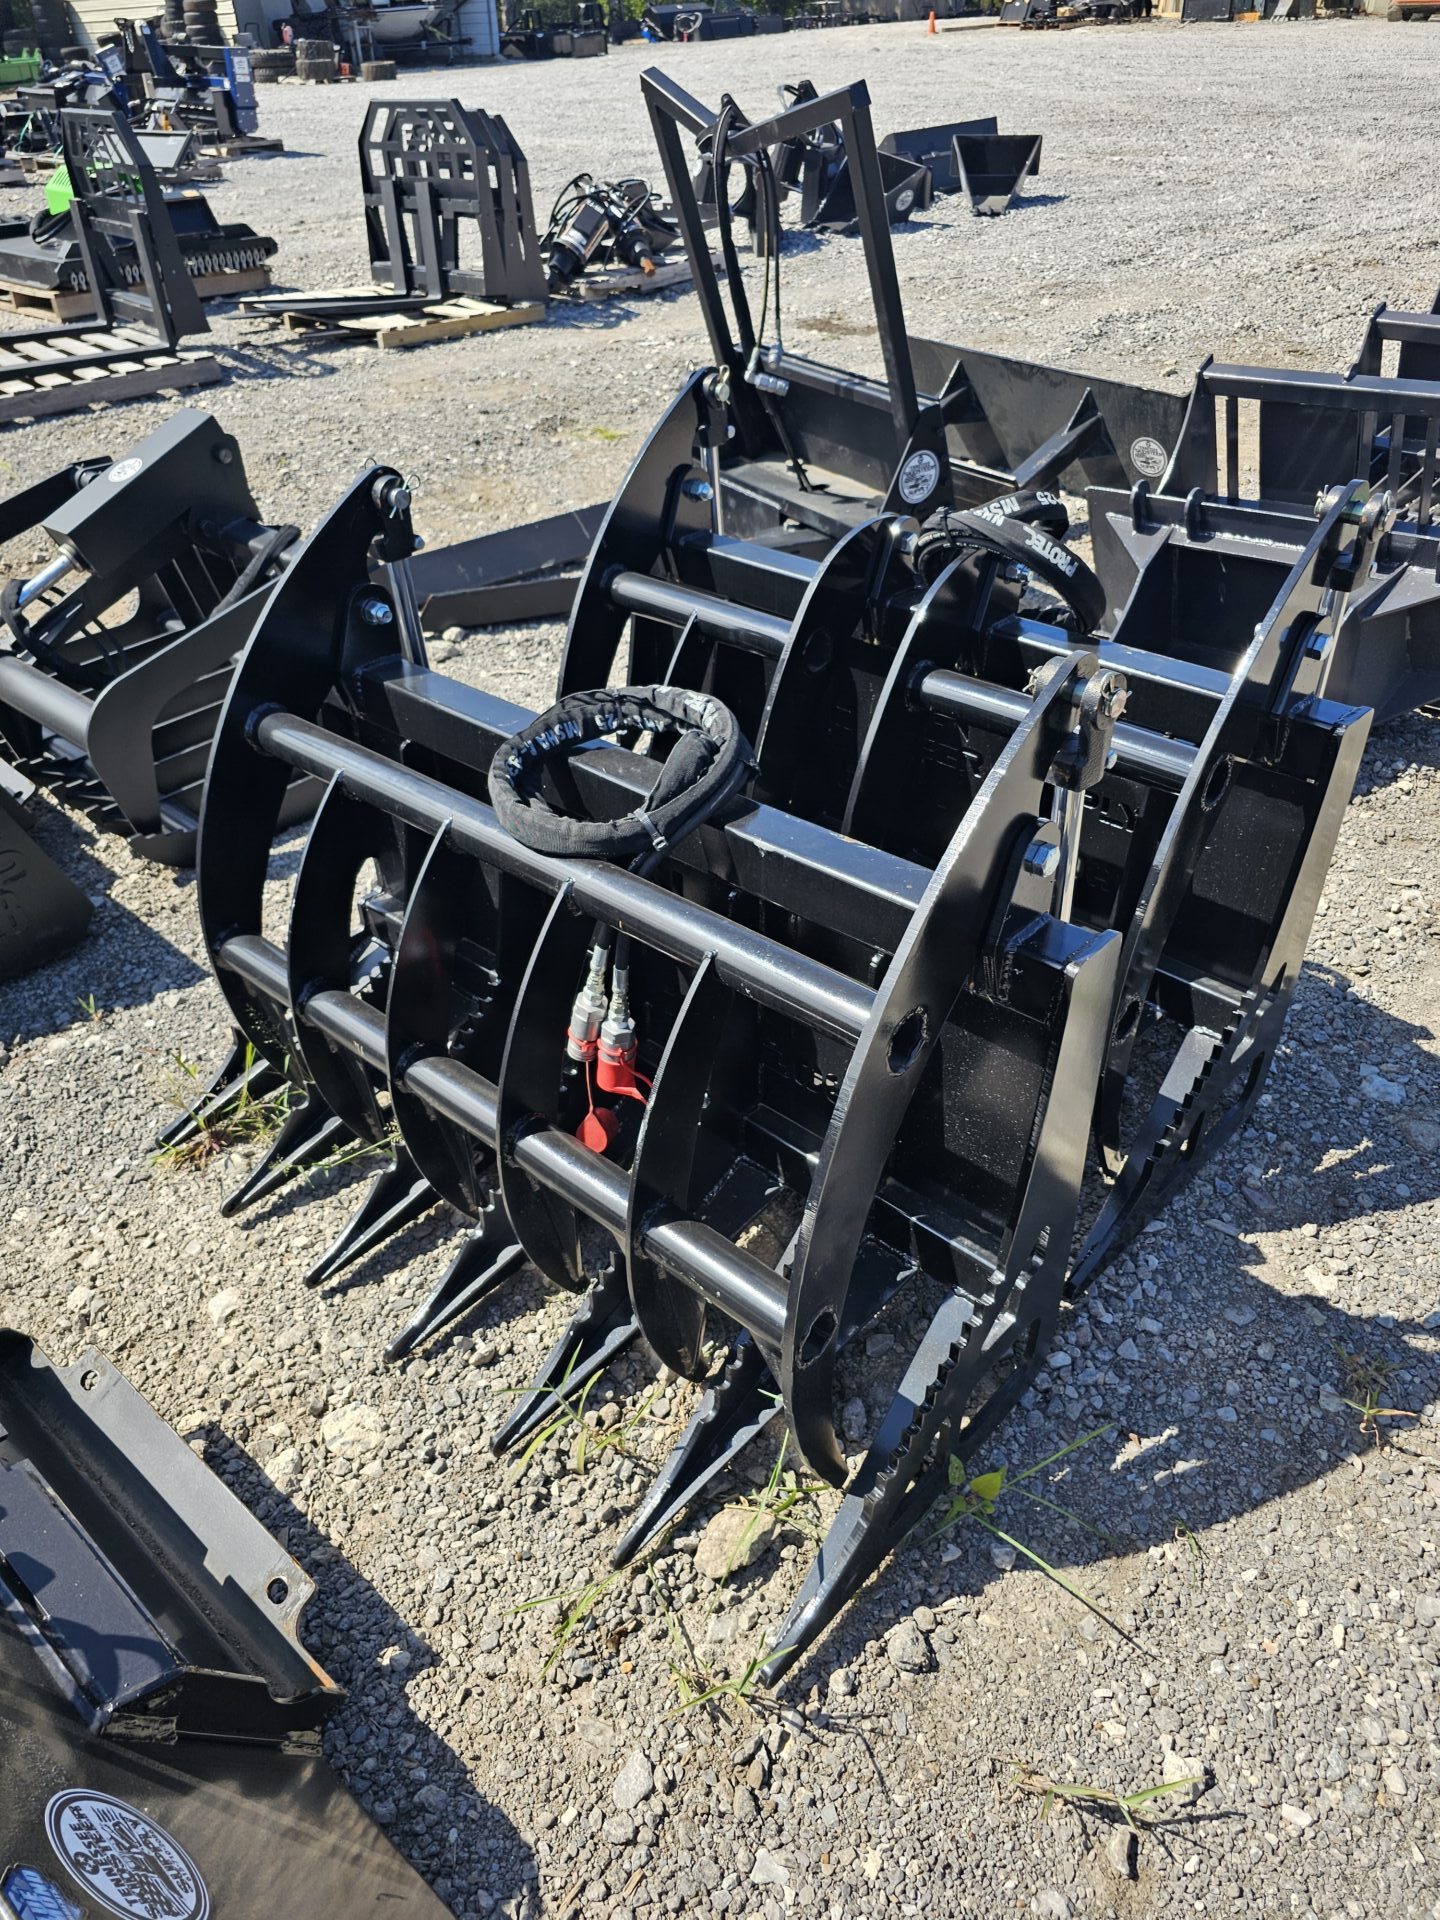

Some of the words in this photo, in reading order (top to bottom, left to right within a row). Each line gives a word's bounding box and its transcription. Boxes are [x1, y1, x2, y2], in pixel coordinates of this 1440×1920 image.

[1022, 525, 1079, 578] PROTEC
[534, 720, 583, 750] MSHA
[68, 1805, 163, 1920] SKIDSTEER
[68, 1823, 138, 1907] TENNESSEE
[125, 1815, 194, 1894] SUPPLY
